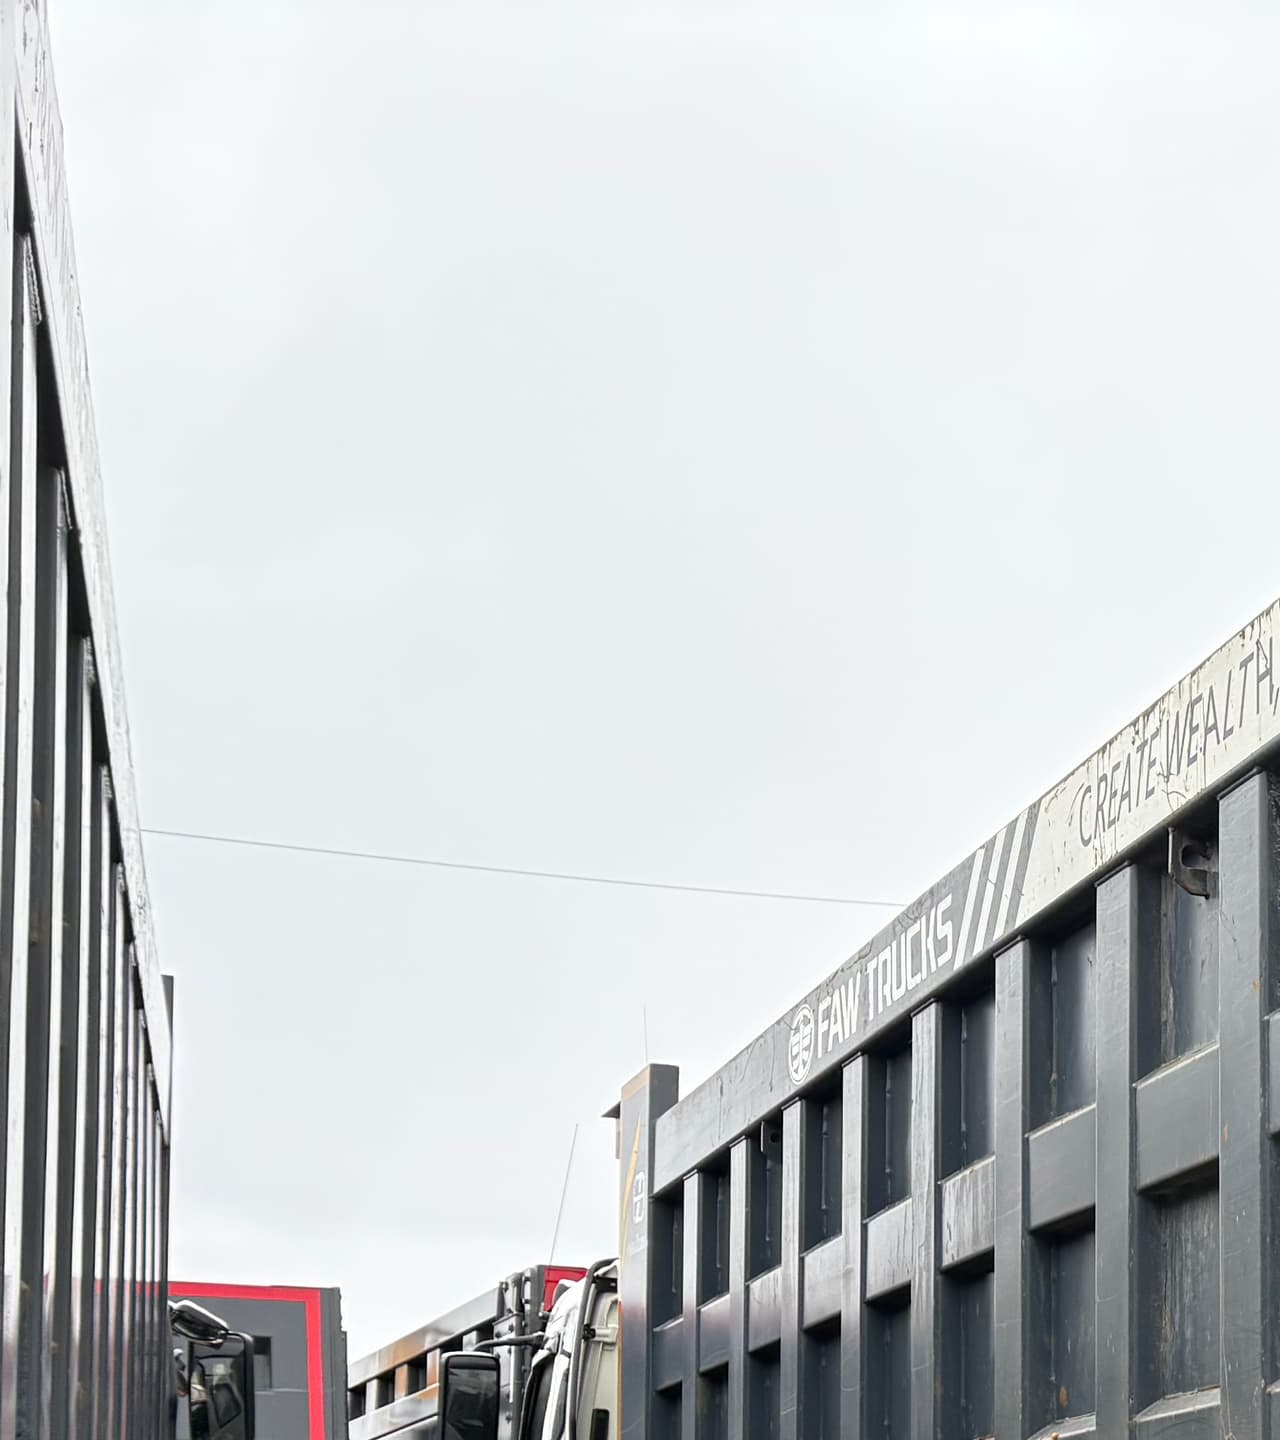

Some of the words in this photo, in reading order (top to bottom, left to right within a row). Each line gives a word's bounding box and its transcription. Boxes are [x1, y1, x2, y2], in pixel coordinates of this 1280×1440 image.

[1079, 725, 1160, 848] CREATE
[817, 971, 862, 1059] FAW
[866, 893, 953, 1021] TRUCKS
